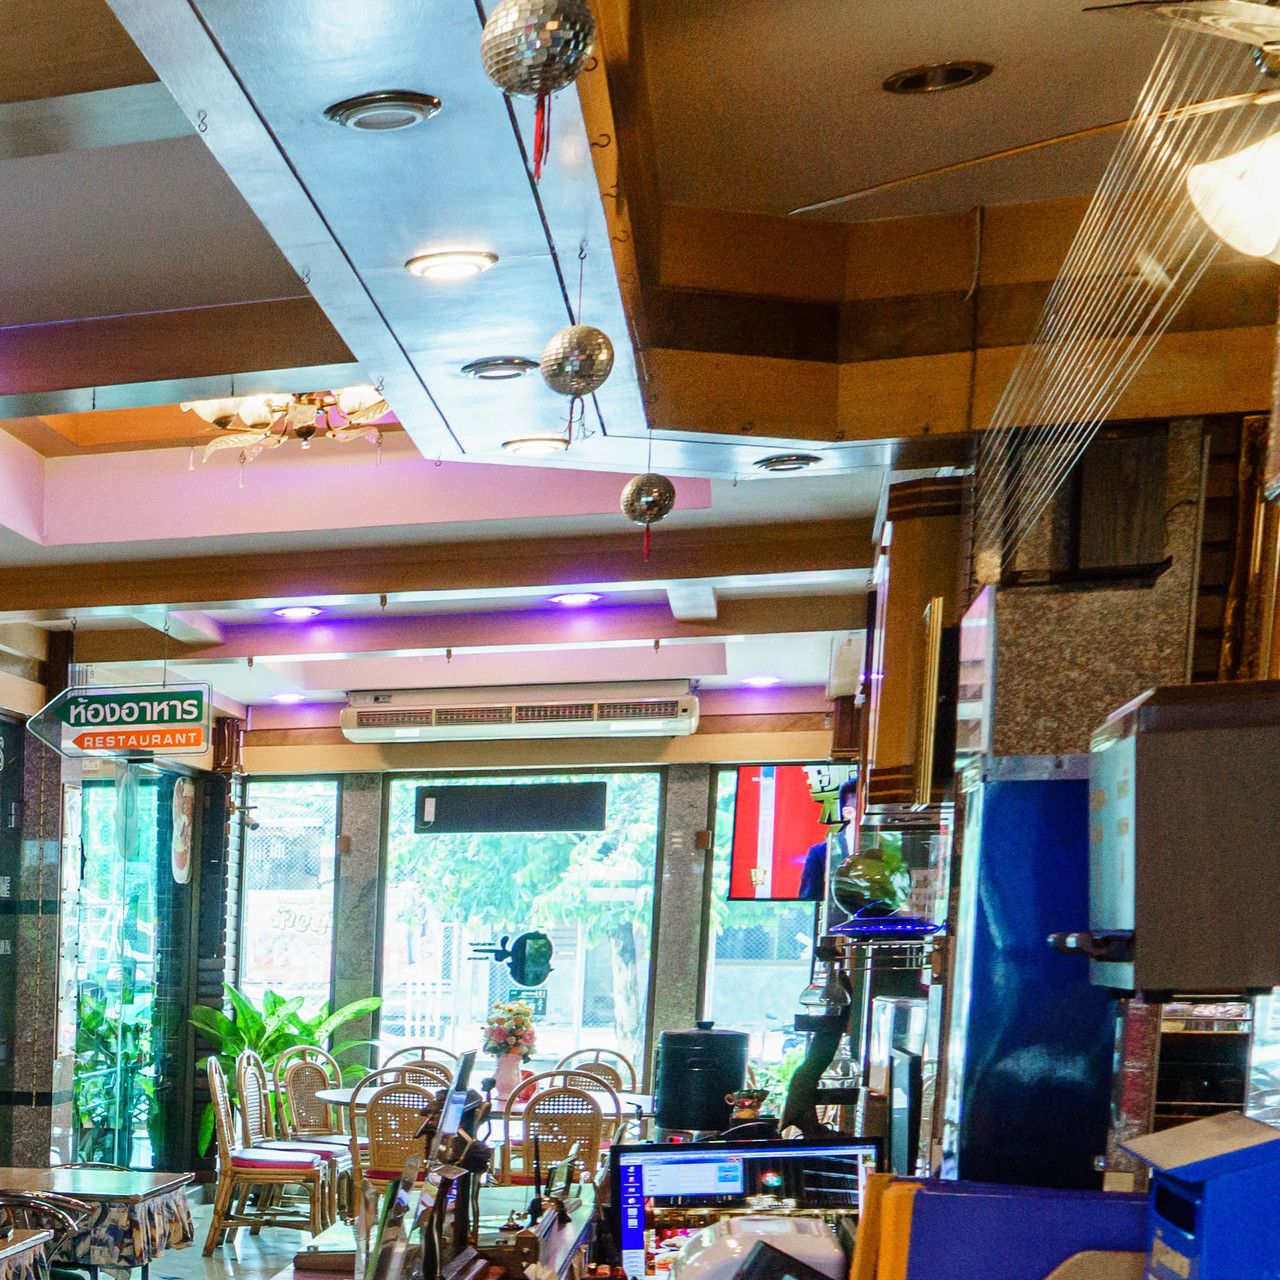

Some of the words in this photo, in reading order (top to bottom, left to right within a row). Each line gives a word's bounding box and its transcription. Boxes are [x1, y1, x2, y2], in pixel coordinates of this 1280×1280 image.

[69, 697, 198, 724] ห้องอาหาร
[83, 732, 197, 748] RESTAURANT
